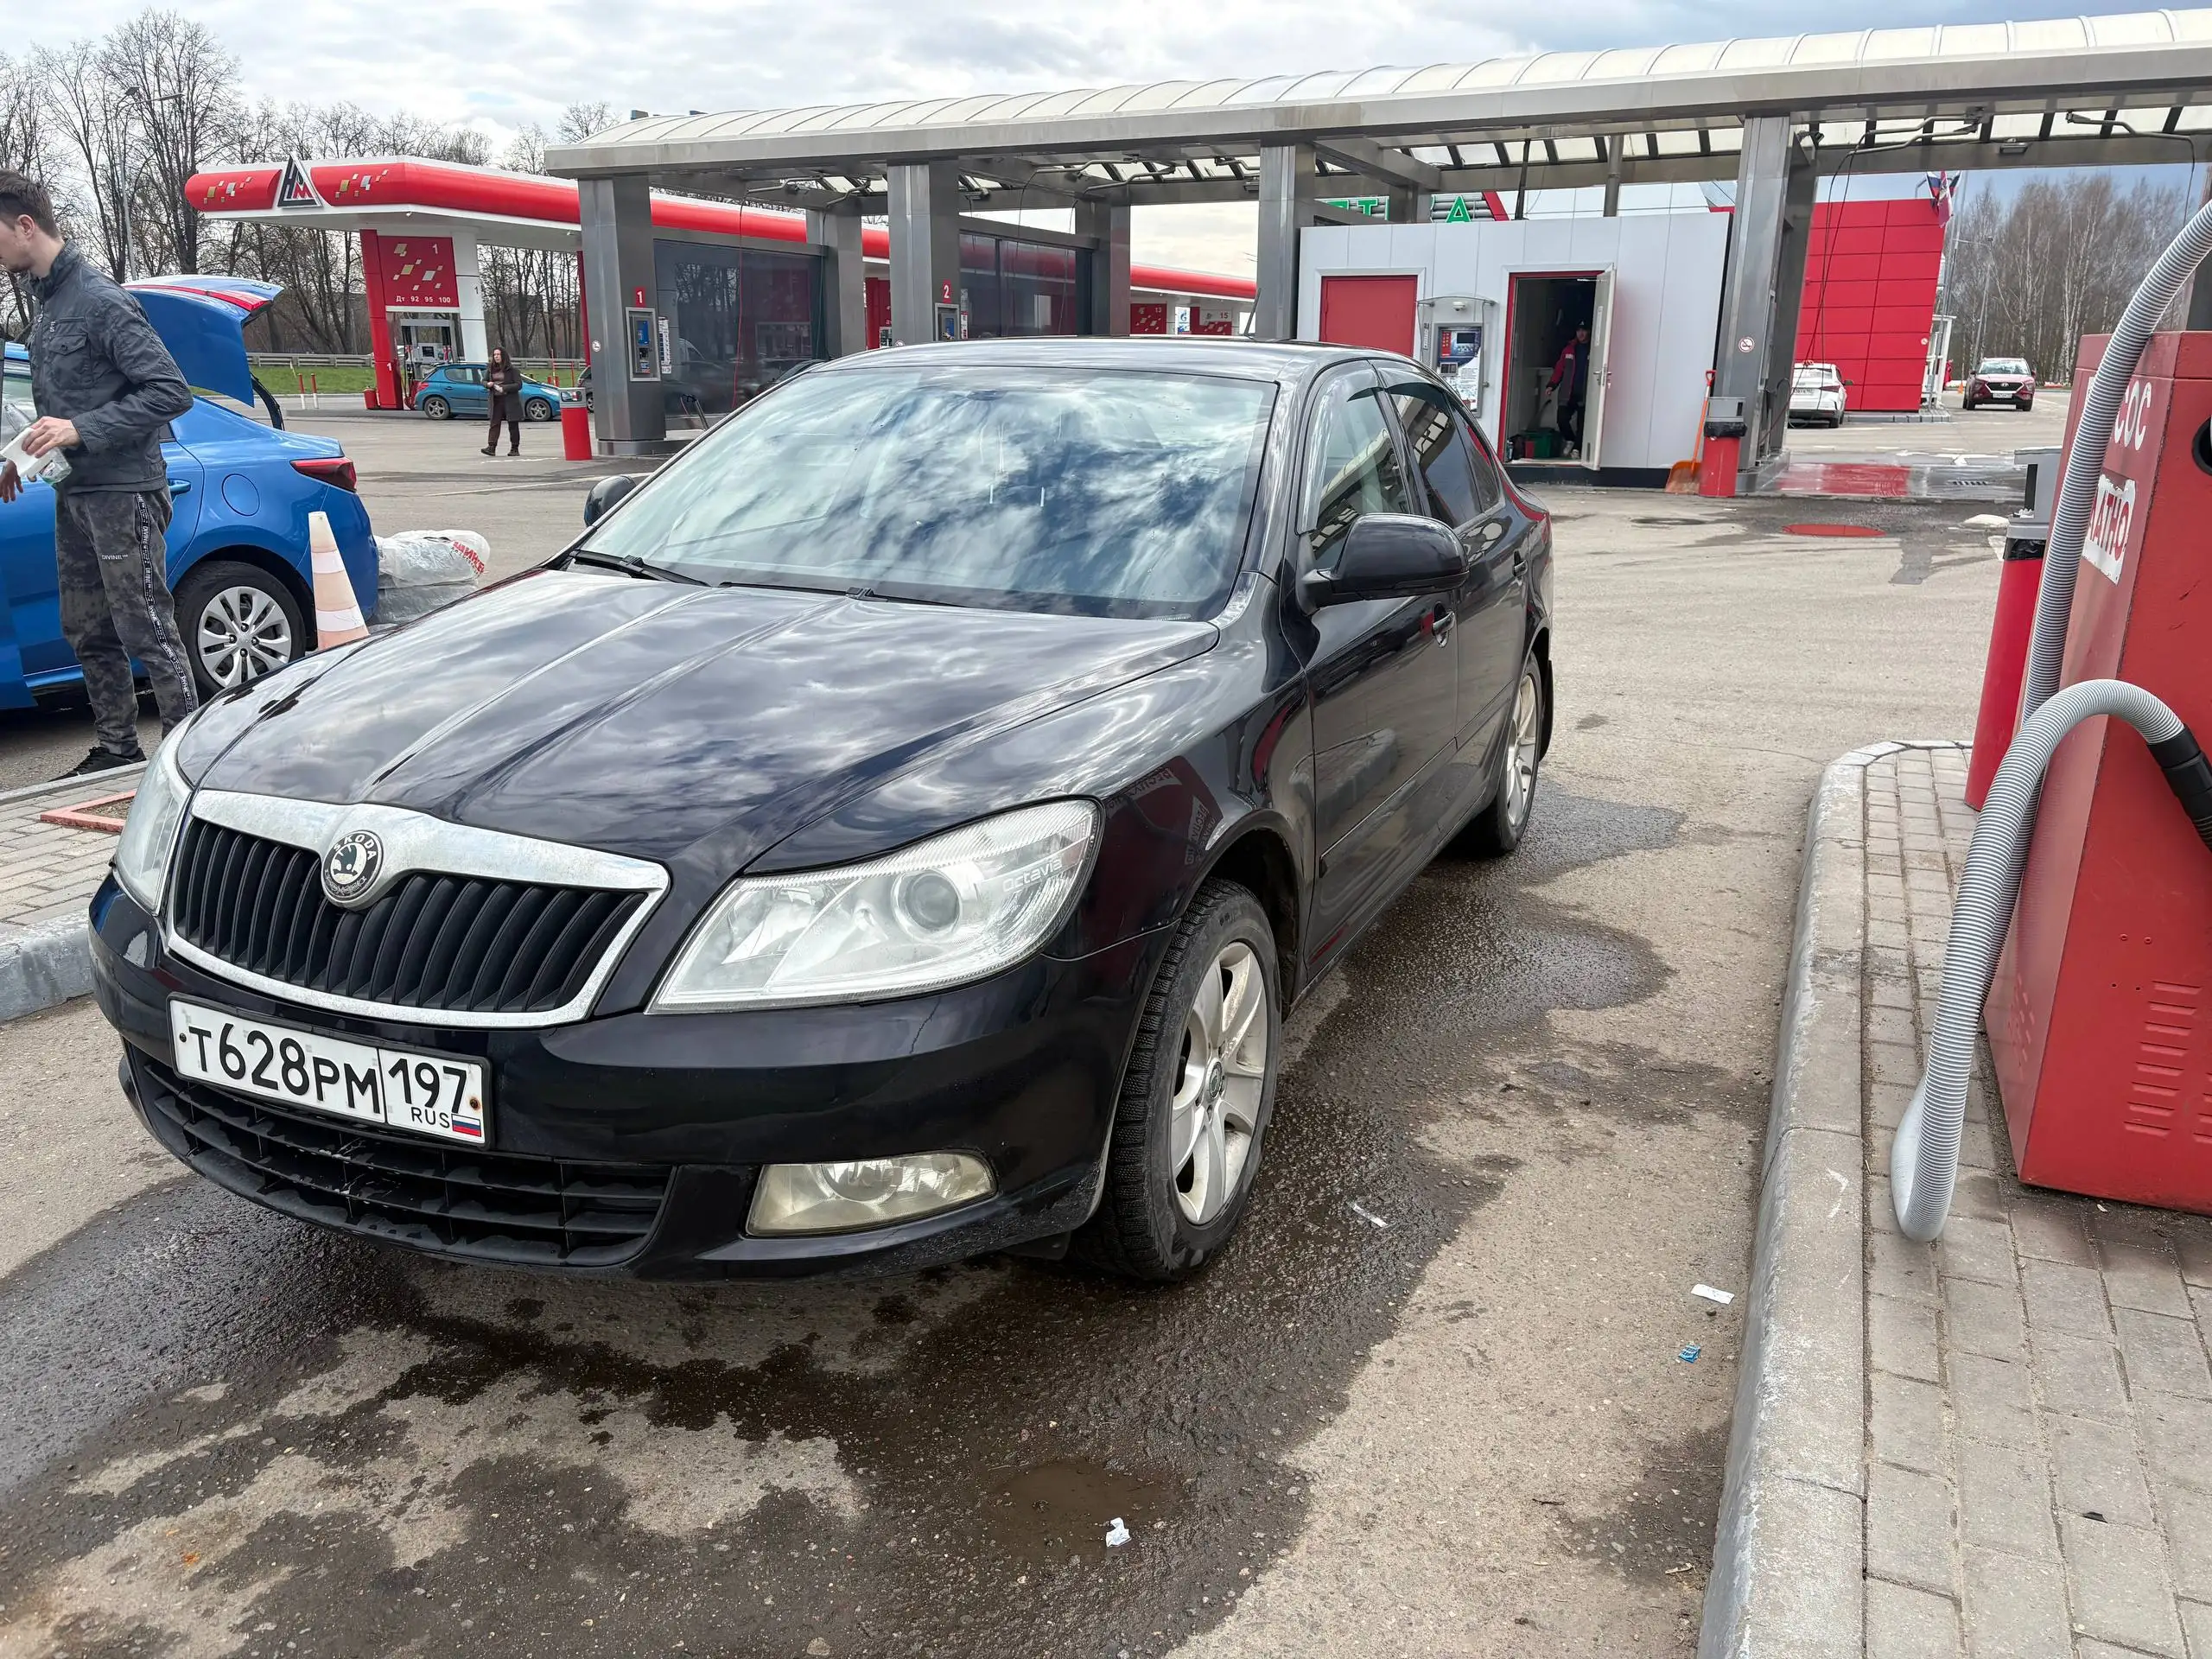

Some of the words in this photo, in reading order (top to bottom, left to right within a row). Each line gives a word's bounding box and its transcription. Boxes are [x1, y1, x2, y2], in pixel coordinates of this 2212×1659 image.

[432, 244, 438, 254] 1
[637, 290, 643, 304] 1
[944, 284, 950, 299] 2
[188, 1022, 381, 1115] Т628РМ
[388, 1058, 467, 1114] 197
[411, 1106, 450, 1129] RUS
